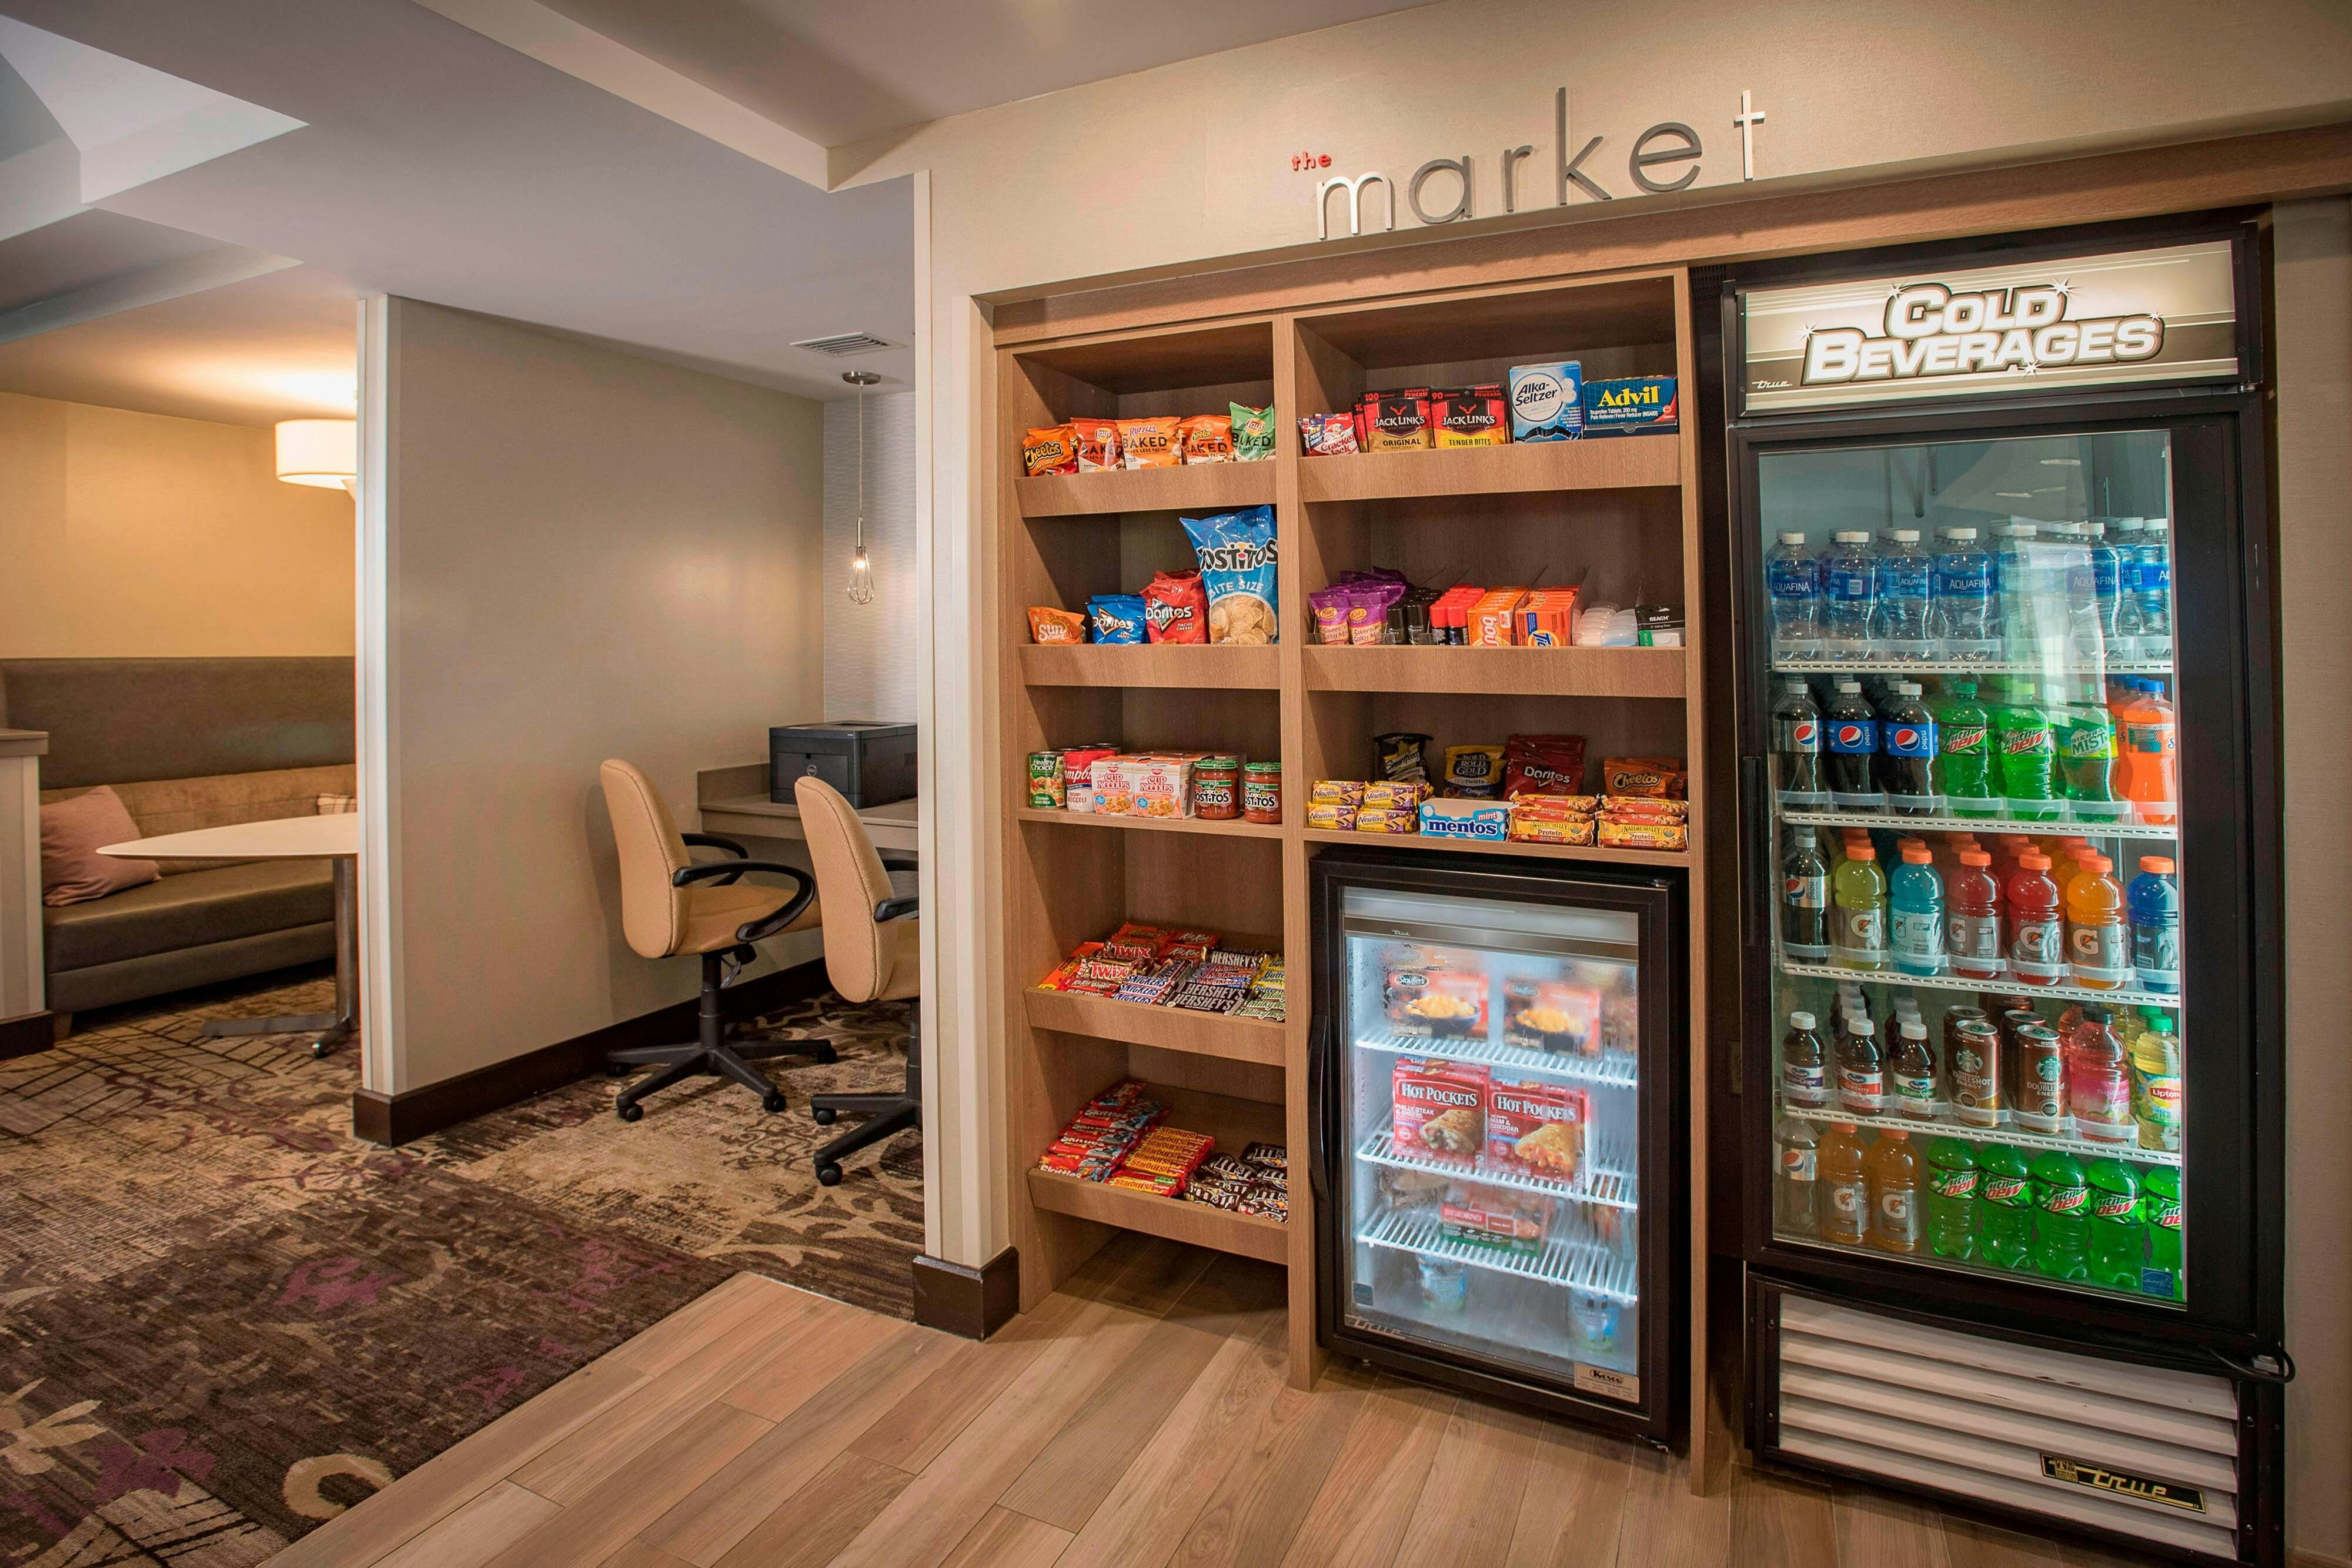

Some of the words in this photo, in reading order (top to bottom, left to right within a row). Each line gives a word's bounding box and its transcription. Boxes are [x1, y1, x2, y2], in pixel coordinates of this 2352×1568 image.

[1292, 151, 1331, 170] the
[1316, 87, 1765, 240] market
[1809, 319, 2160, 383] BEVERAGES
[1518, 383, 1550, 396] Alka-
[1364, 393, 1379, 401] 100
[1515, 389, 1558, 406] Seltzer
[1597, 386, 1659, 407] Advil
[1374, 418, 1398, 427] JACK
[1442, 416, 1466, 425] JACK
[1129, 426, 1157, 436] RUFFLES
[1192, 429, 1212, 442] Cheetos
[1123, 437, 1167, 449] BAKED
[1025, 441, 1062, 467] Cheetos
[1900, 578, 1928, 586] AQUAFIN
[1949, 578, 1992, 590] AQUAFINA
[2073, 576, 2119, 587] AQUAFINA
[1208, 581, 1234, 597] BITE
[1238, 580, 1264, 592] SIZE
[1146, 607, 1192, 620] Doritos
[2072, 727, 2103, 743] SIERRA
[2072, 731, 2106, 755] MIST
[1033, 757, 1055, 767] Healthy
[1456, 767, 1486, 775] GOLD
[1524, 766, 1571, 783] Doritos
[1104, 773, 1124, 782] CUP
[1148, 775, 1167, 784] CUP
[1613, 771, 1662, 790] Cheetos
[1097, 781, 1130, 790] NOODLES
[1140, 783, 1173, 793] NOODLES
[1365, 792, 1391, 800] Newtons
[1465, 788, 1491, 796] Original
[1245, 795, 1275, 807] OSTITOS
[1478, 812, 1497, 821] mint
[1428, 819, 1497, 835] mentos
[2019, 927, 2046, 952] G
[2073, 928, 2099, 954] G
[1111, 944, 1151, 958] TWIX
[1211, 951, 1257, 968] HERSHEY'S
[1089, 962, 1131, 979] TWIX
[1127, 975, 1167, 988] SNICKERS
[1398, 975, 1426, 985] Stouffer's
[1120, 984, 1162, 996] SNICKERS
[1187, 984, 1246, 1001] HERSHEY'S
[1175, 994, 1235, 1011] HERSHEY'S
[1956, 1079, 1982, 1090] ENERGY
[1401, 1083, 1425, 1099] HOT
[1426, 1086, 1478, 1107] POCKETS
[2153, 1089, 2180, 1098] Lipton
[1084, 1109, 1128, 1119] Skittles
[1395, 1103, 1414, 1111] PHILLY
[1415, 1107, 1435, 1115] STEAK
[1497, 1096, 1521, 1113] HOT
[1522, 1101, 1576, 1121] POCKETS
[1160, 1127, 1197, 1139] Starburst
[1491, 1123, 1519, 1133] CHEDDAR
[1147, 1139, 1182, 1151] Starburst
[1152, 1134, 1188, 1146] Starburst
[1141, 1146, 1178, 1158] Starburst
[1134, 1152, 1170, 1165] Starburst
[1131, 1159, 1168, 1172] Starburst
[1114, 1178, 1152, 1190] Starburst
[1833, 1187, 1856, 1212] G
[1882, 1193, 1906, 1218] G
